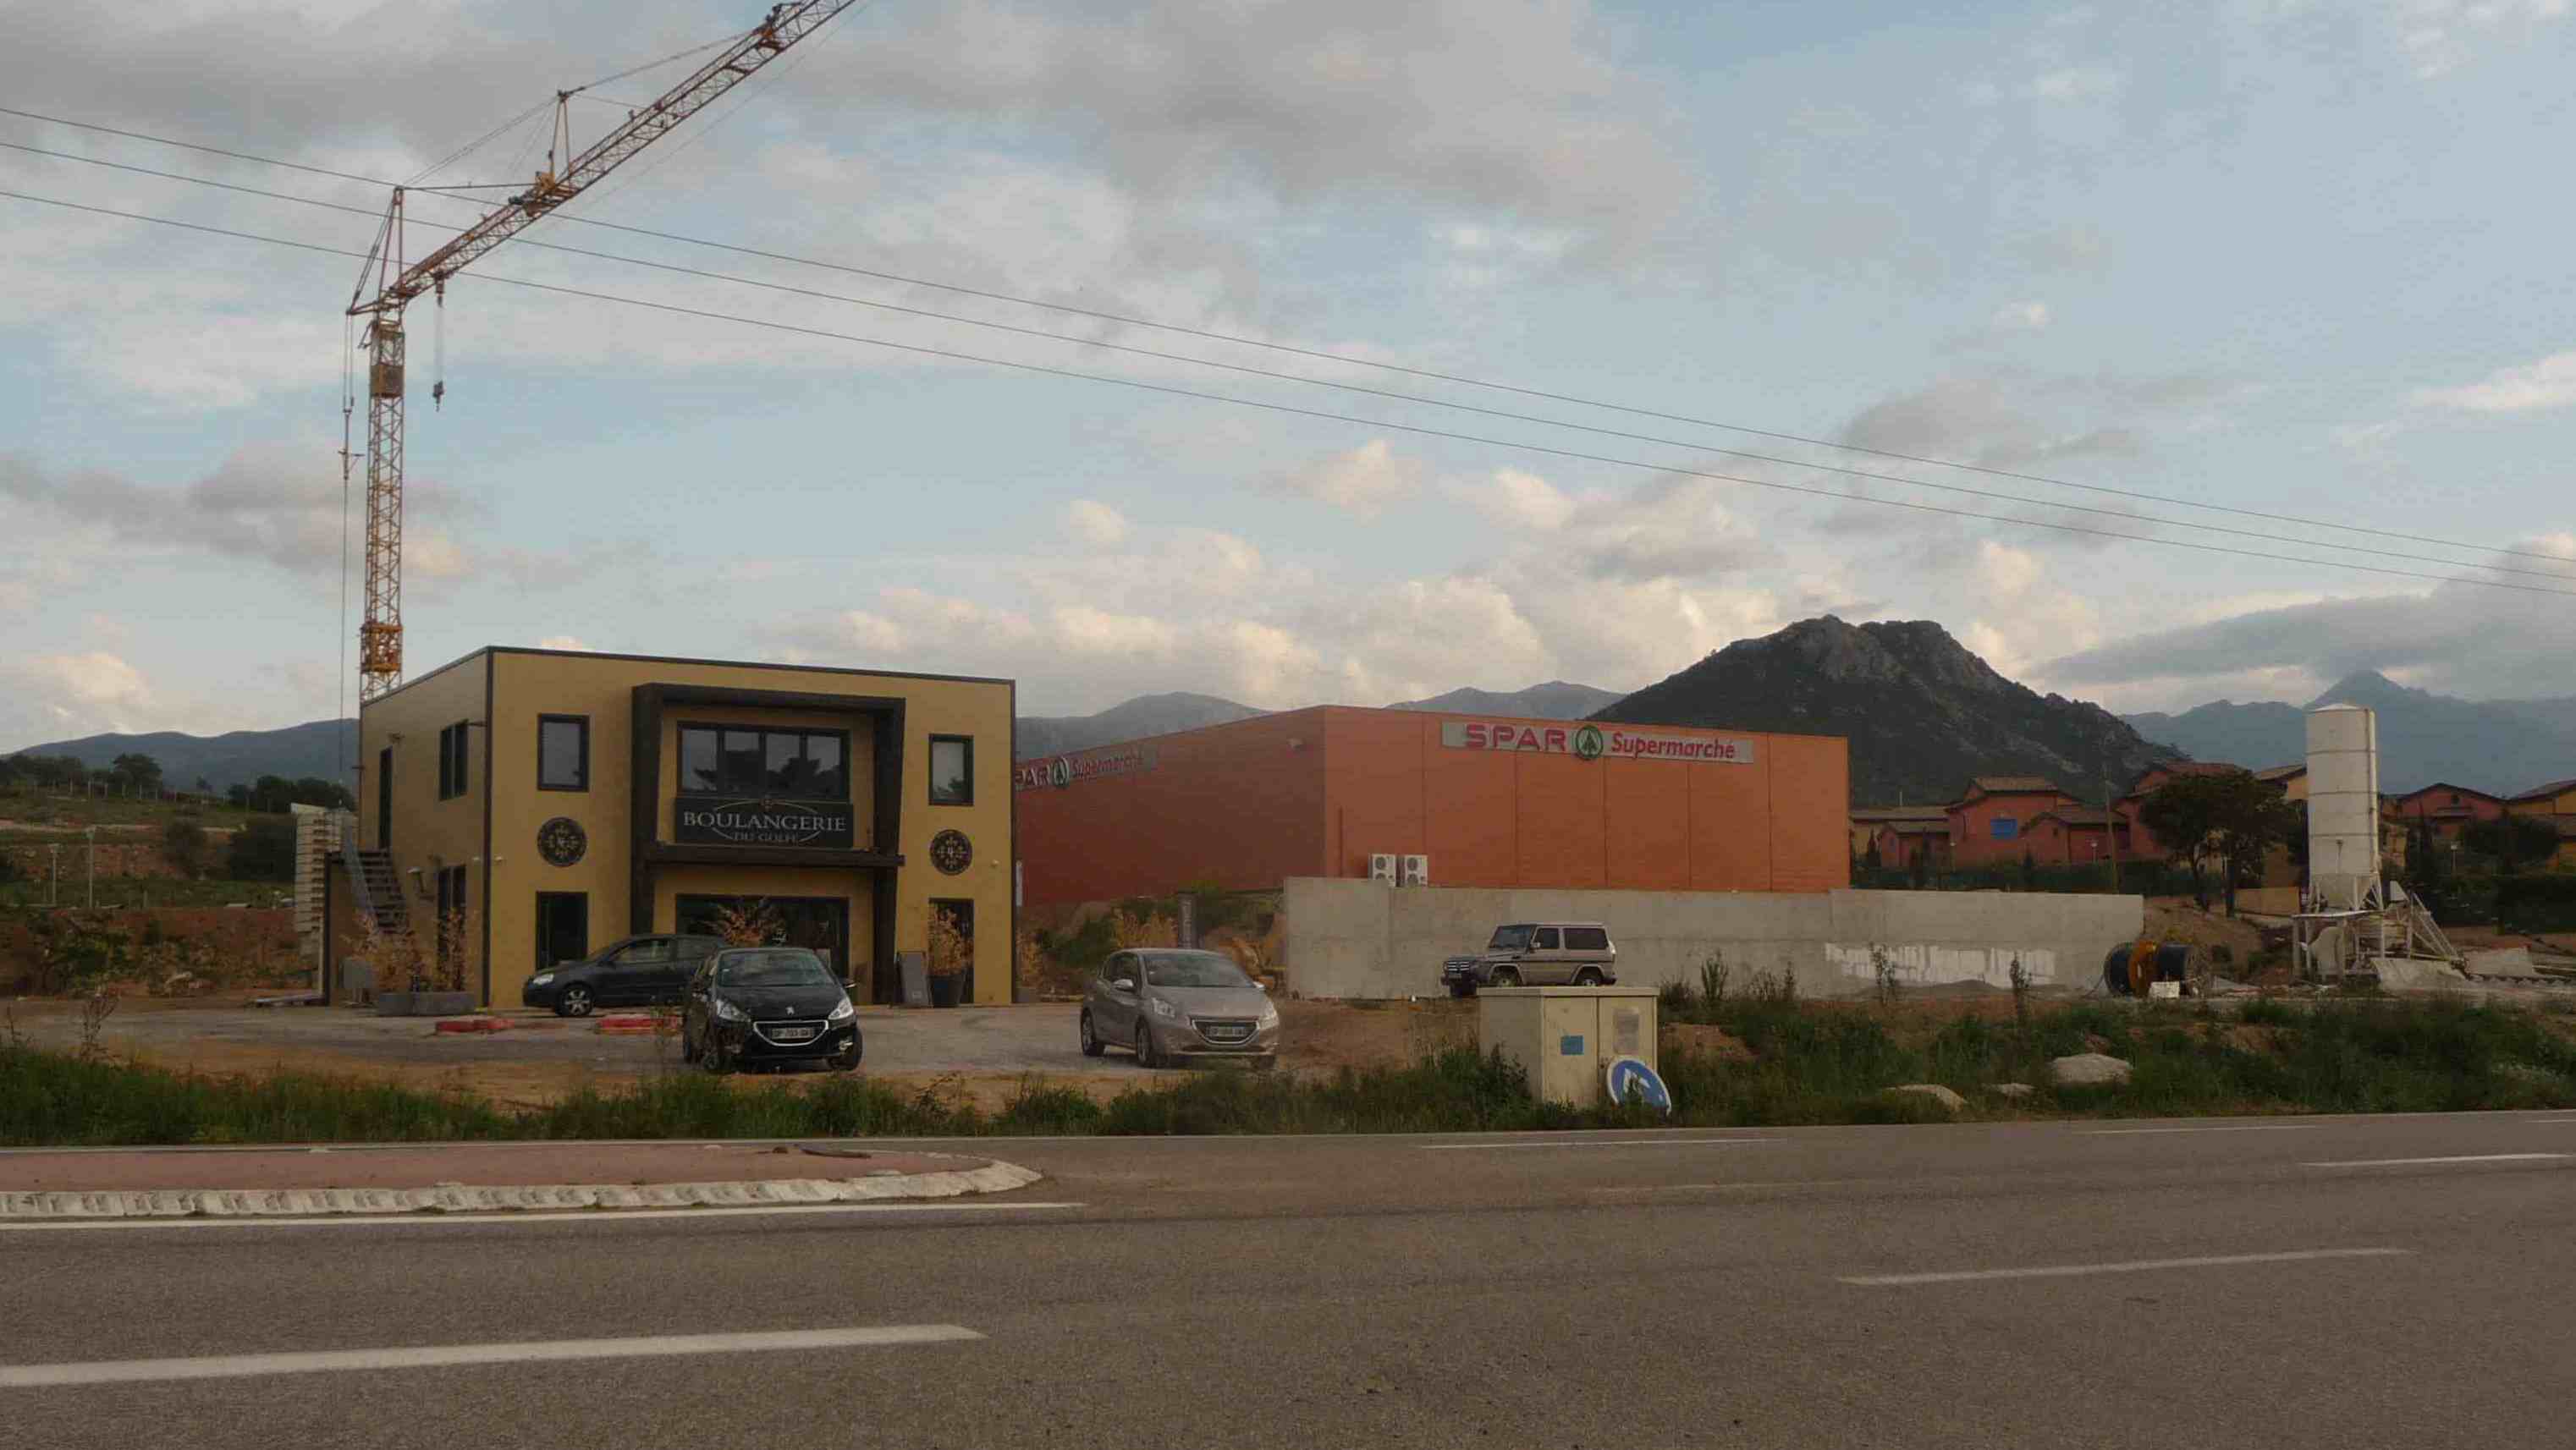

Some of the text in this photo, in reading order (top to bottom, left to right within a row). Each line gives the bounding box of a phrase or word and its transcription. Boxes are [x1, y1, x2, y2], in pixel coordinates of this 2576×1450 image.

[1466, 723, 1735, 759] SPAR Supermarché
[1016, 764, 1051, 786] PAR
[683, 811, 847, 832] BOULANGERIE
